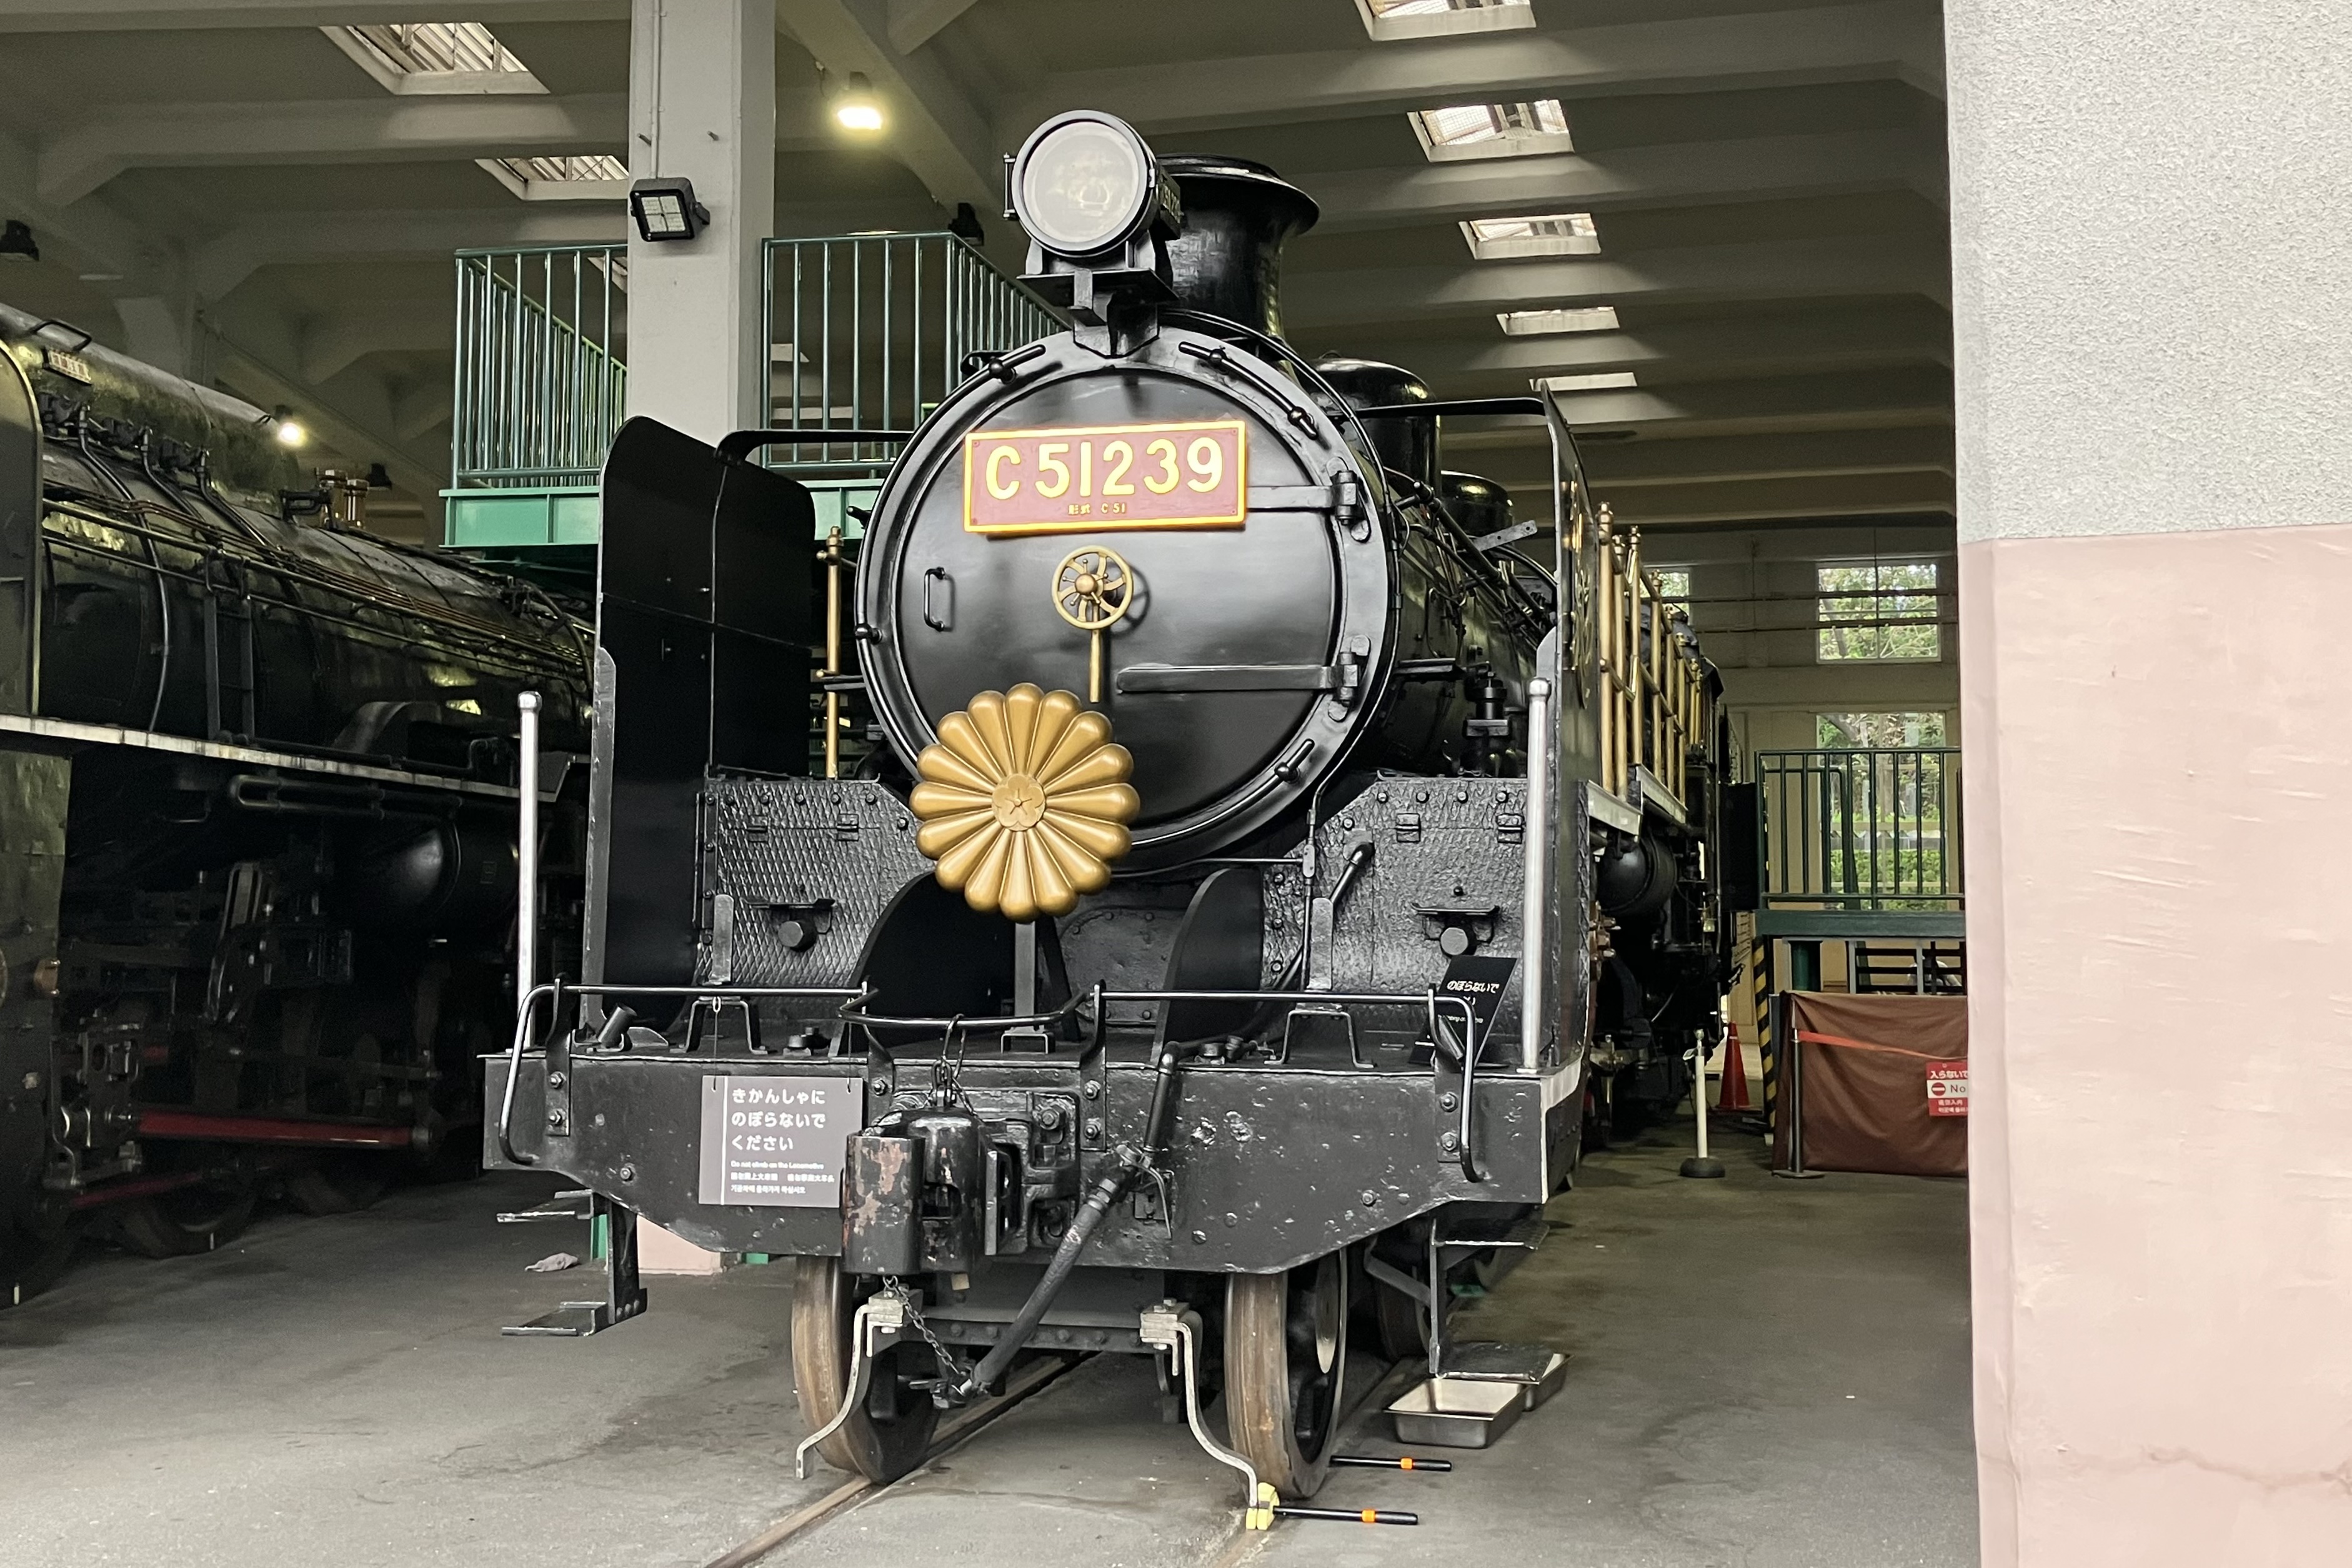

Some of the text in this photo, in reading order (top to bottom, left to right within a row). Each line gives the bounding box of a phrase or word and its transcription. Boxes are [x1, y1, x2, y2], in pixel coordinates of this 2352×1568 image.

[732, 1088, 825, 1104] きかんしゃに
[1950, 1084, 1966, 1093] No
[731, 1111, 826, 1128] のぼらないで
[732, 1134, 794, 1151] ください
